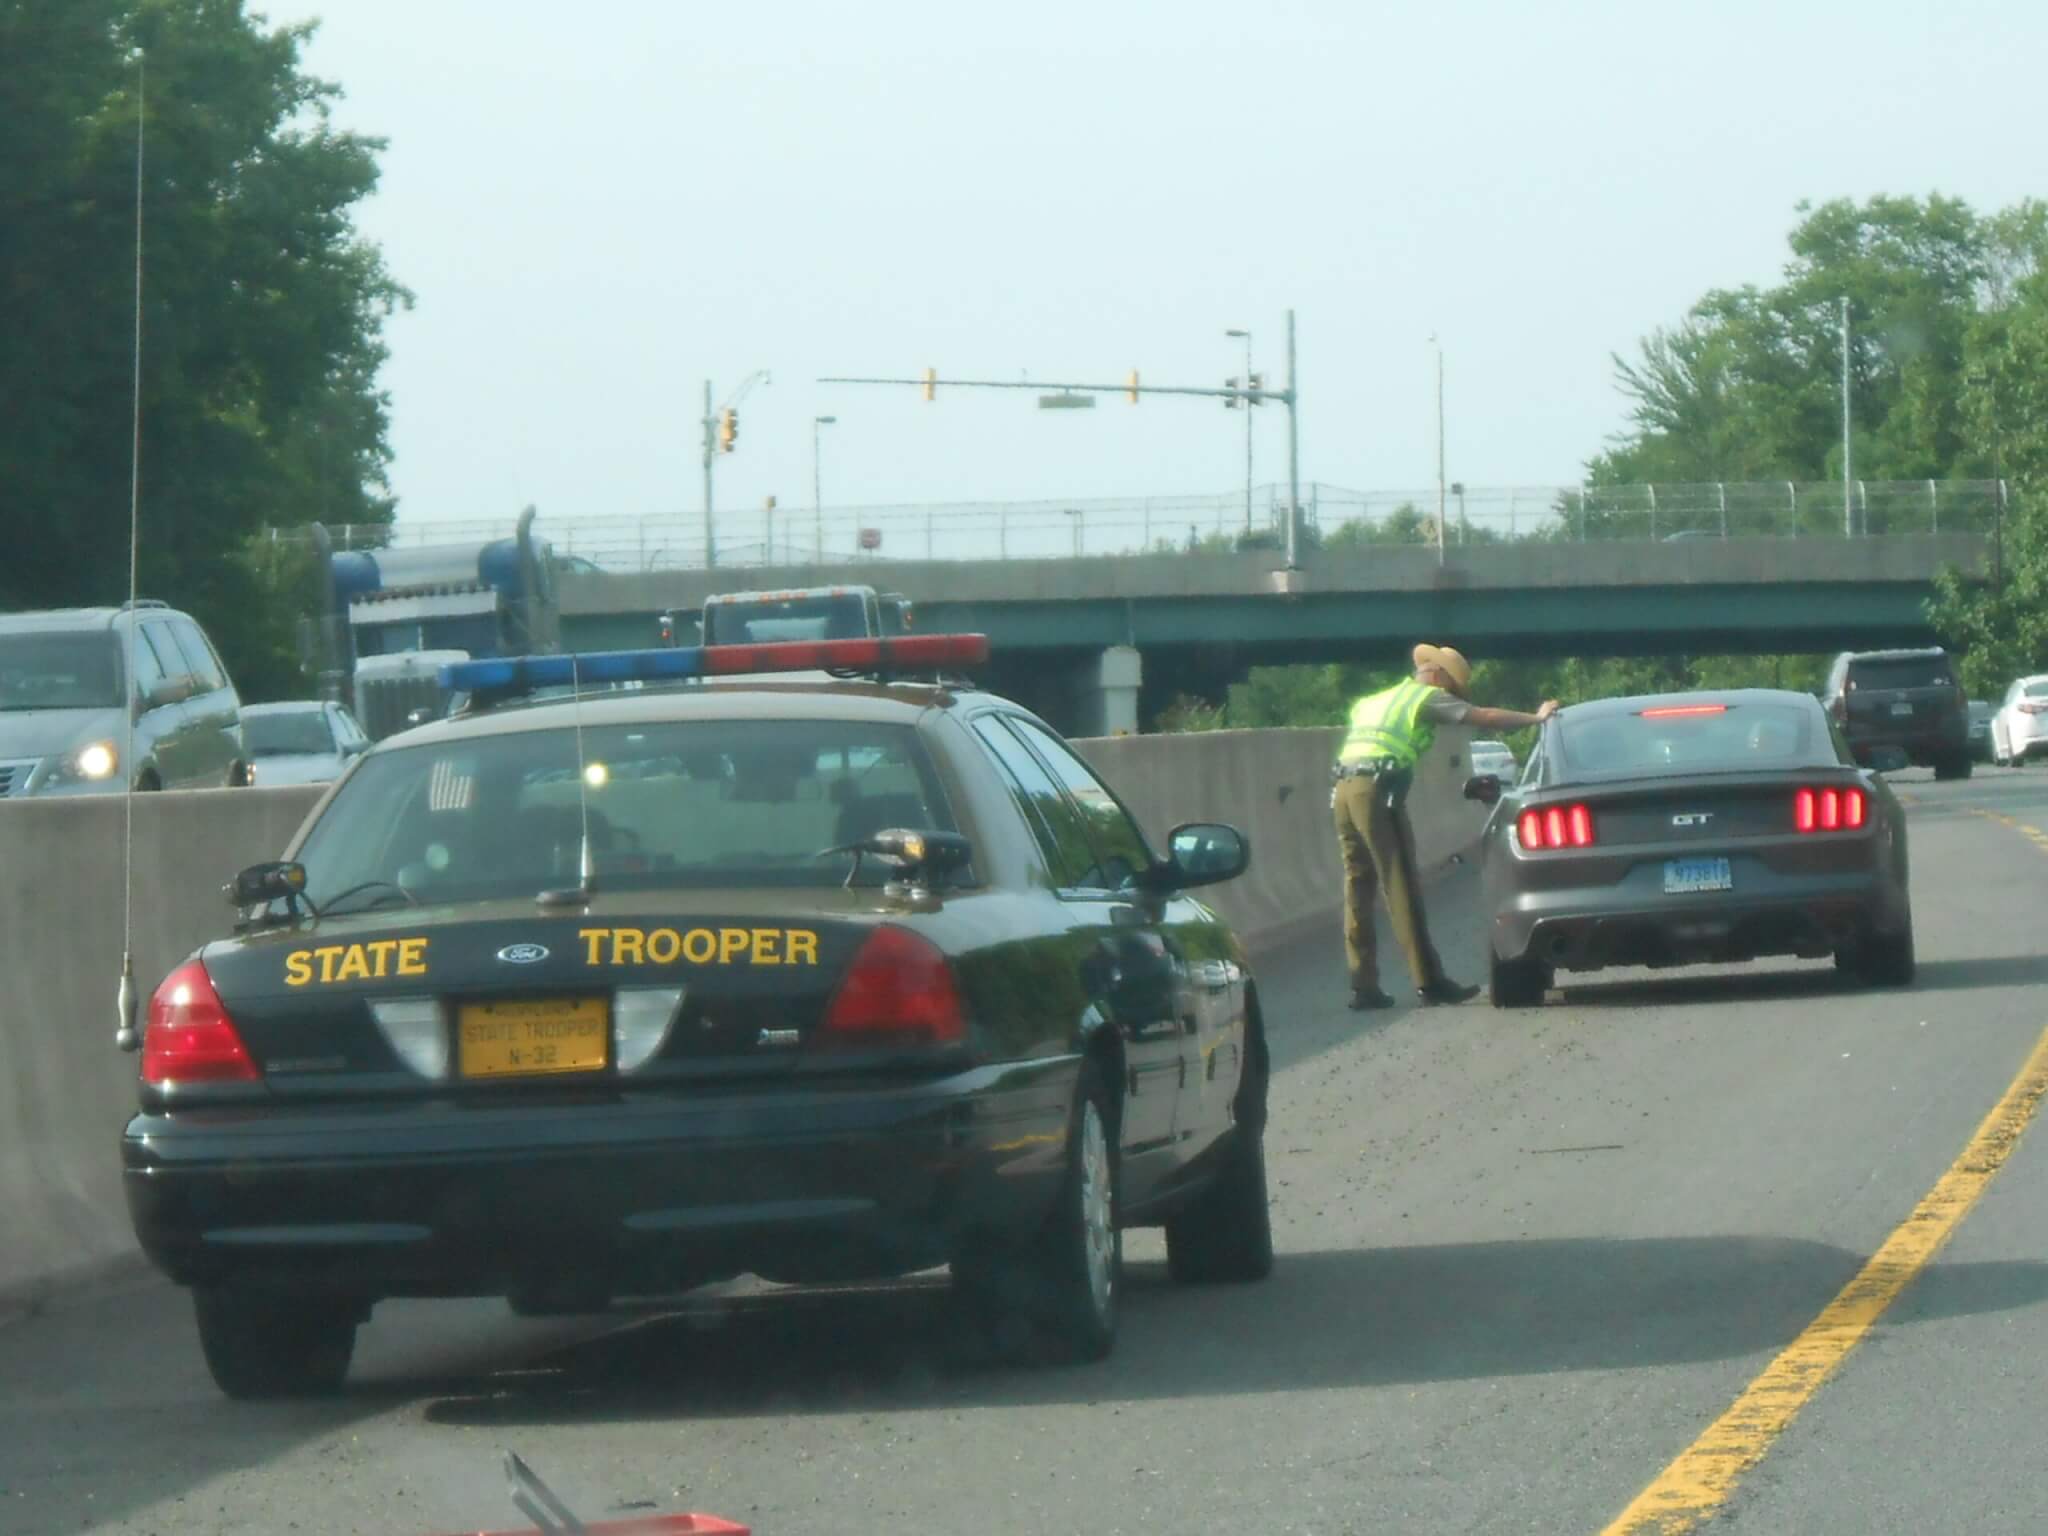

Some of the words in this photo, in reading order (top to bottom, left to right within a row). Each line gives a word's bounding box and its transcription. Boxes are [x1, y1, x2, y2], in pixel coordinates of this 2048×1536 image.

[284, 937, 428, 986] STATE
[579, 928, 818, 965] TROOPER
[465, 1024, 518, 1043] STATE
[524, 1018, 600, 1040] TROOPER
